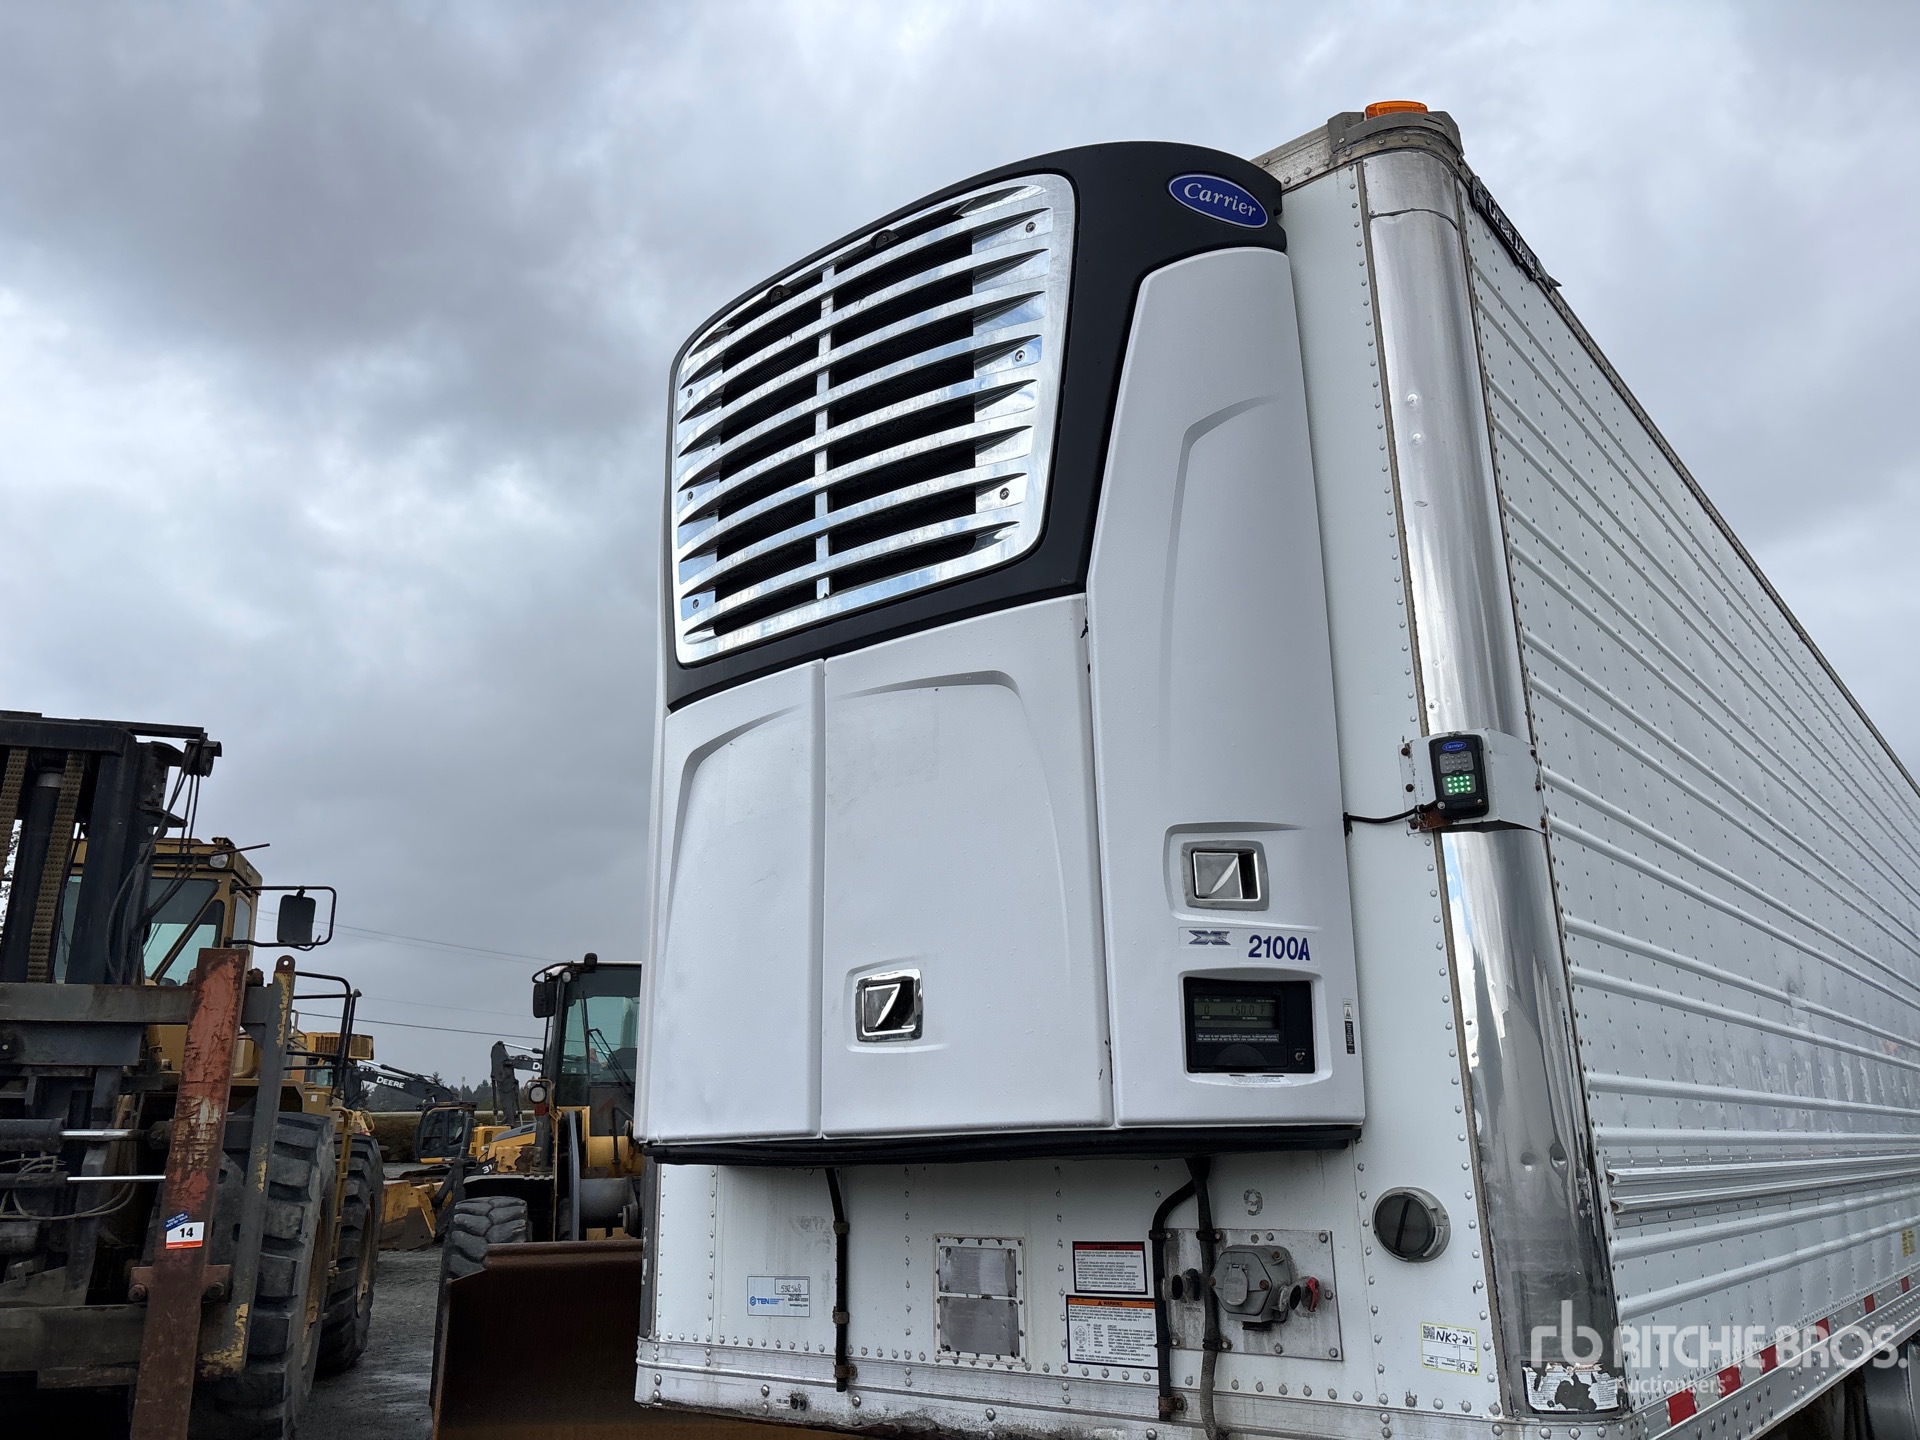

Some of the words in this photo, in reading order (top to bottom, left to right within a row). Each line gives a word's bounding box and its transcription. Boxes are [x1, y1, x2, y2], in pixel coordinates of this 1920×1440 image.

[1184, 182, 1257, 217] Carrier
[1248, 935, 1311, 961] 2100A
[377, 1076, 405, 1089] DEERE
[179, 1227, 194, 1238] 14
